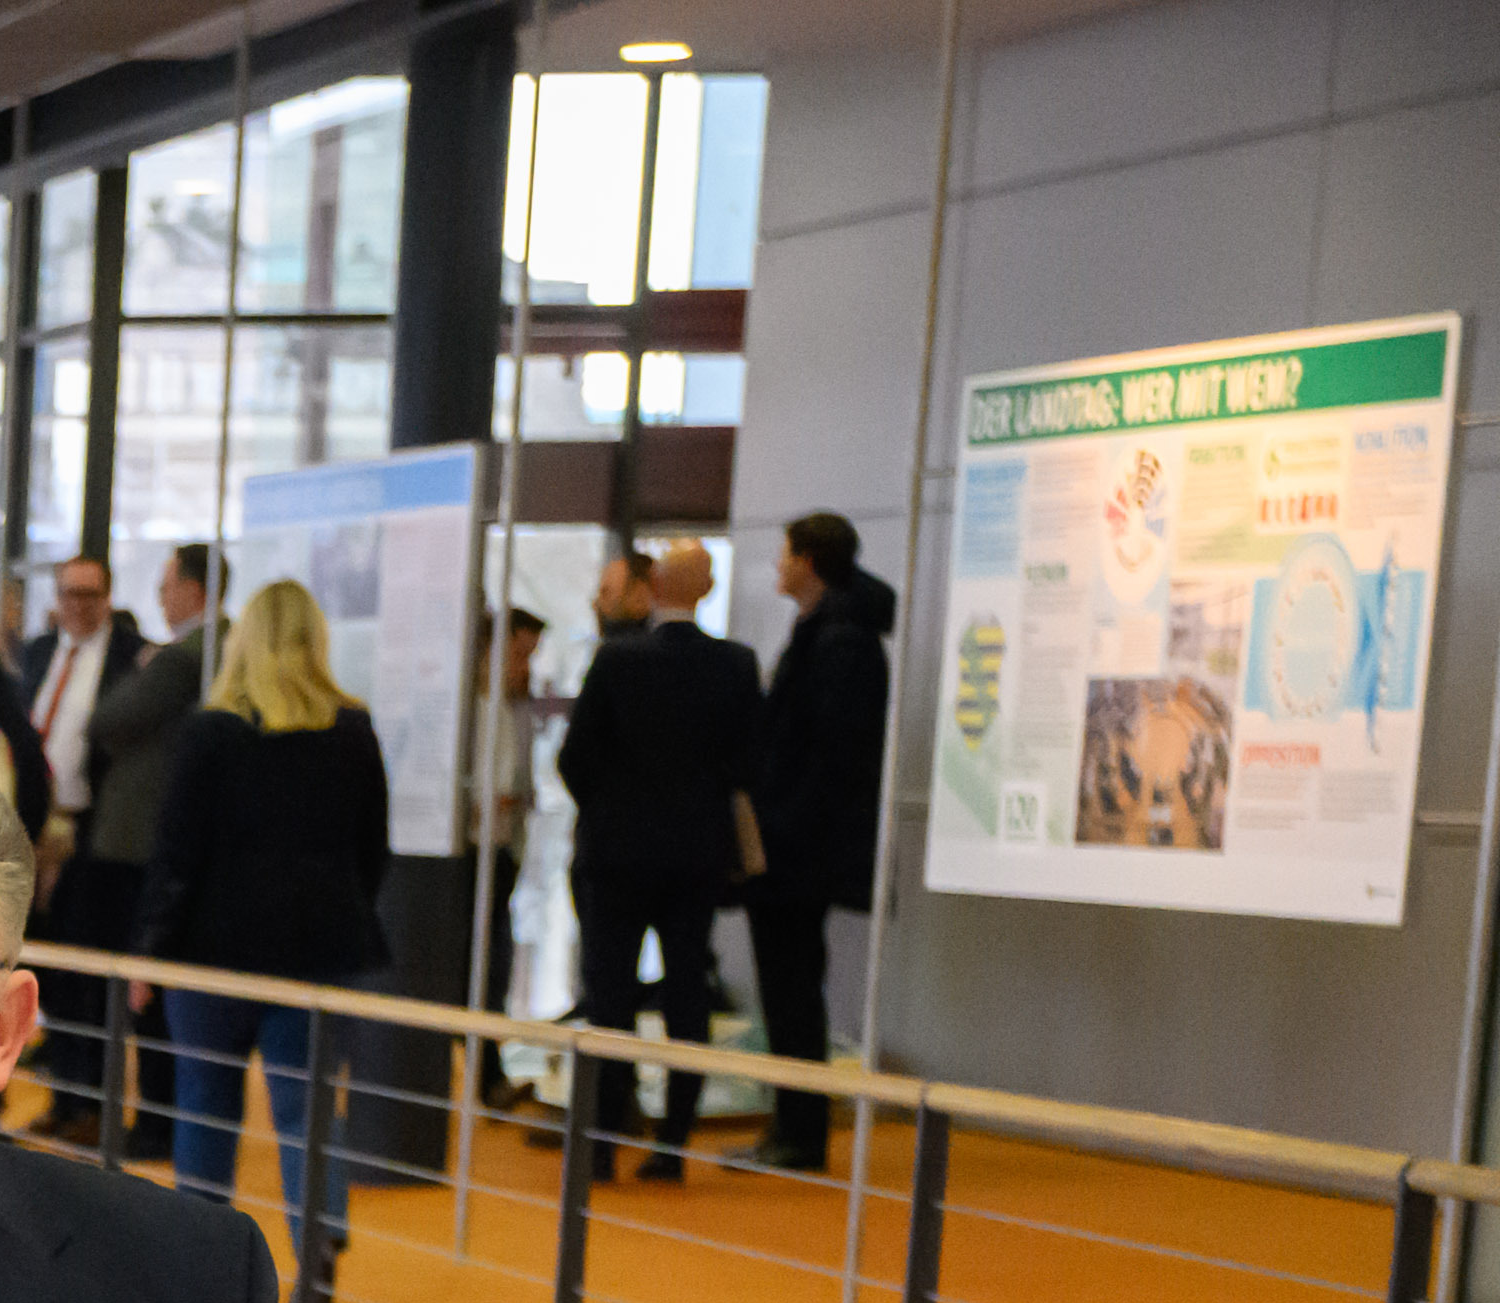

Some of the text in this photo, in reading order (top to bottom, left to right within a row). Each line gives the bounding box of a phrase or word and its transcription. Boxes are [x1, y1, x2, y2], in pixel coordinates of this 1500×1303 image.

[970, 355, 1303, 441] DER LANDTAG: WER MIT WEM?
